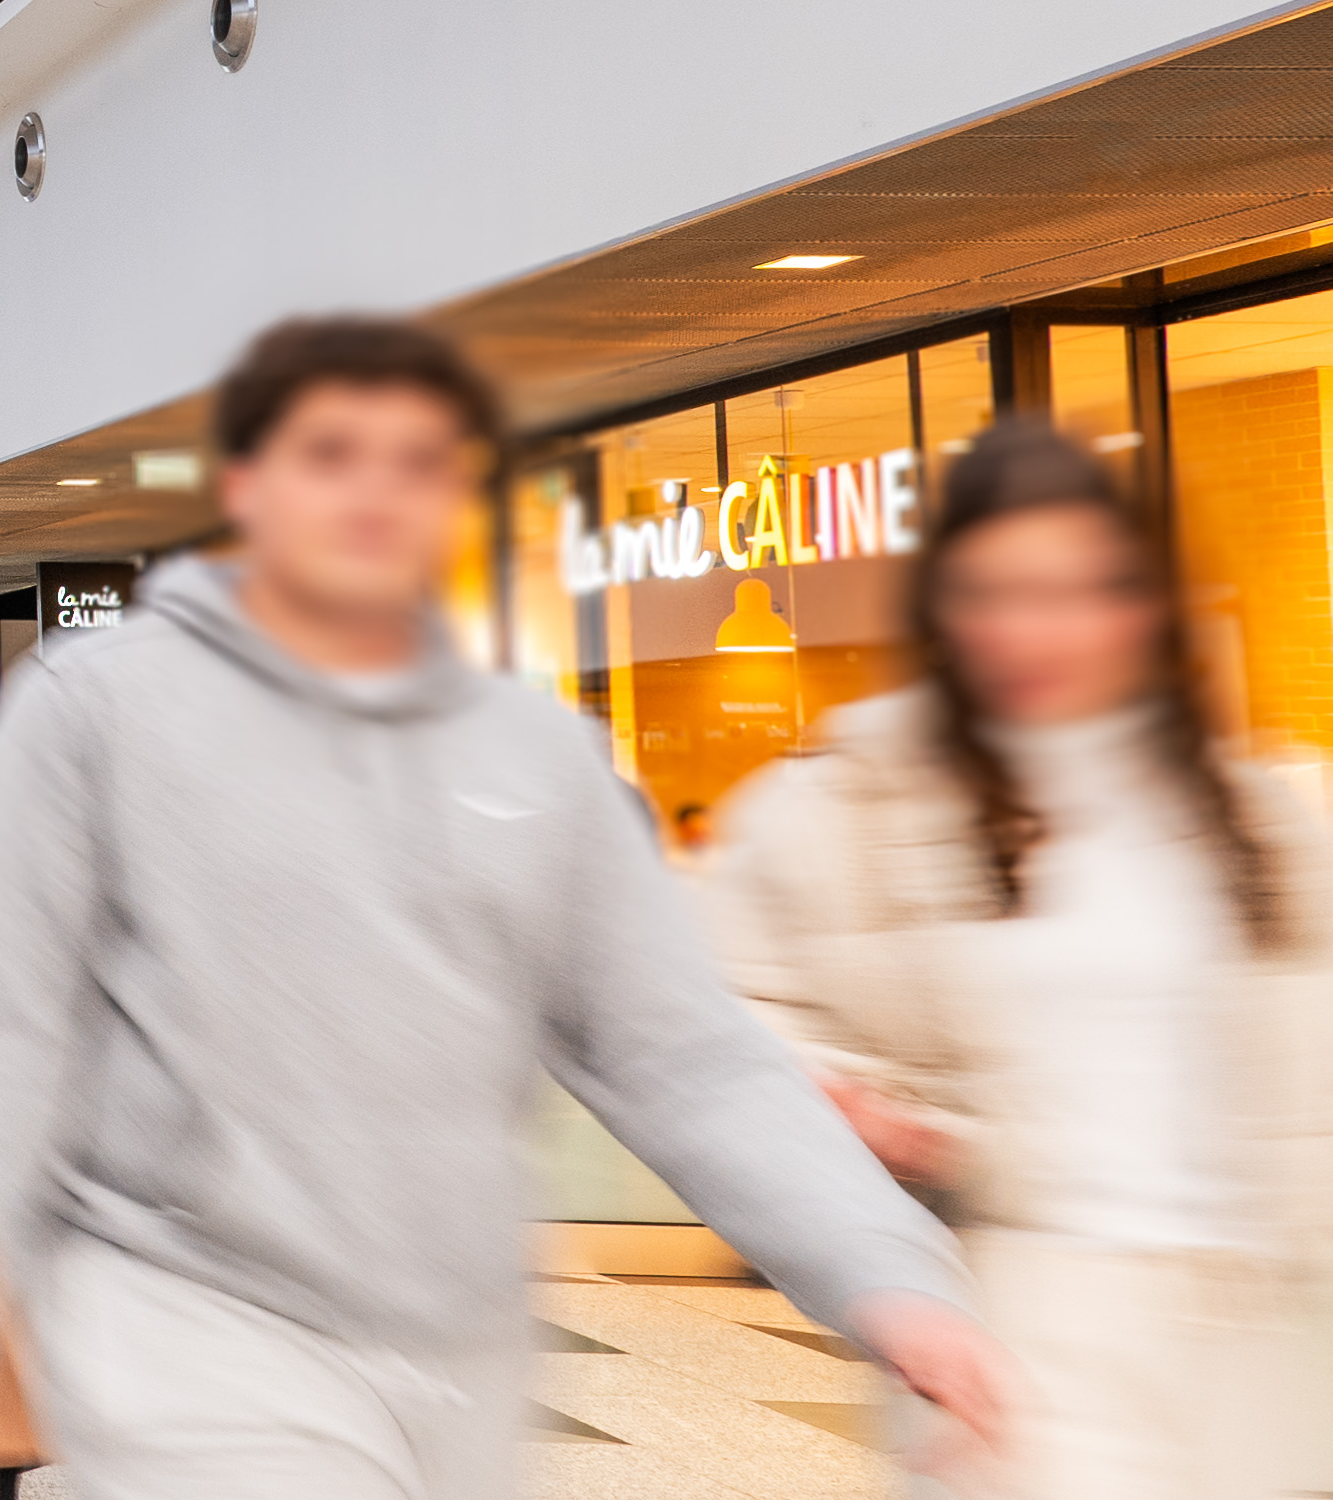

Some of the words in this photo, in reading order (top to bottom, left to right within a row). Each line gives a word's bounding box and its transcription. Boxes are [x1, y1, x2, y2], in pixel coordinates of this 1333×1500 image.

[561, 497, 610, 594] la
[613, 480, 717, 587] mie
[719, 454, 923, 572] CÂLINE
[58, 586, 79, 607] la
[80, 585, 122, 607] mie
[58, 607, 122, 628] CÂLINE
